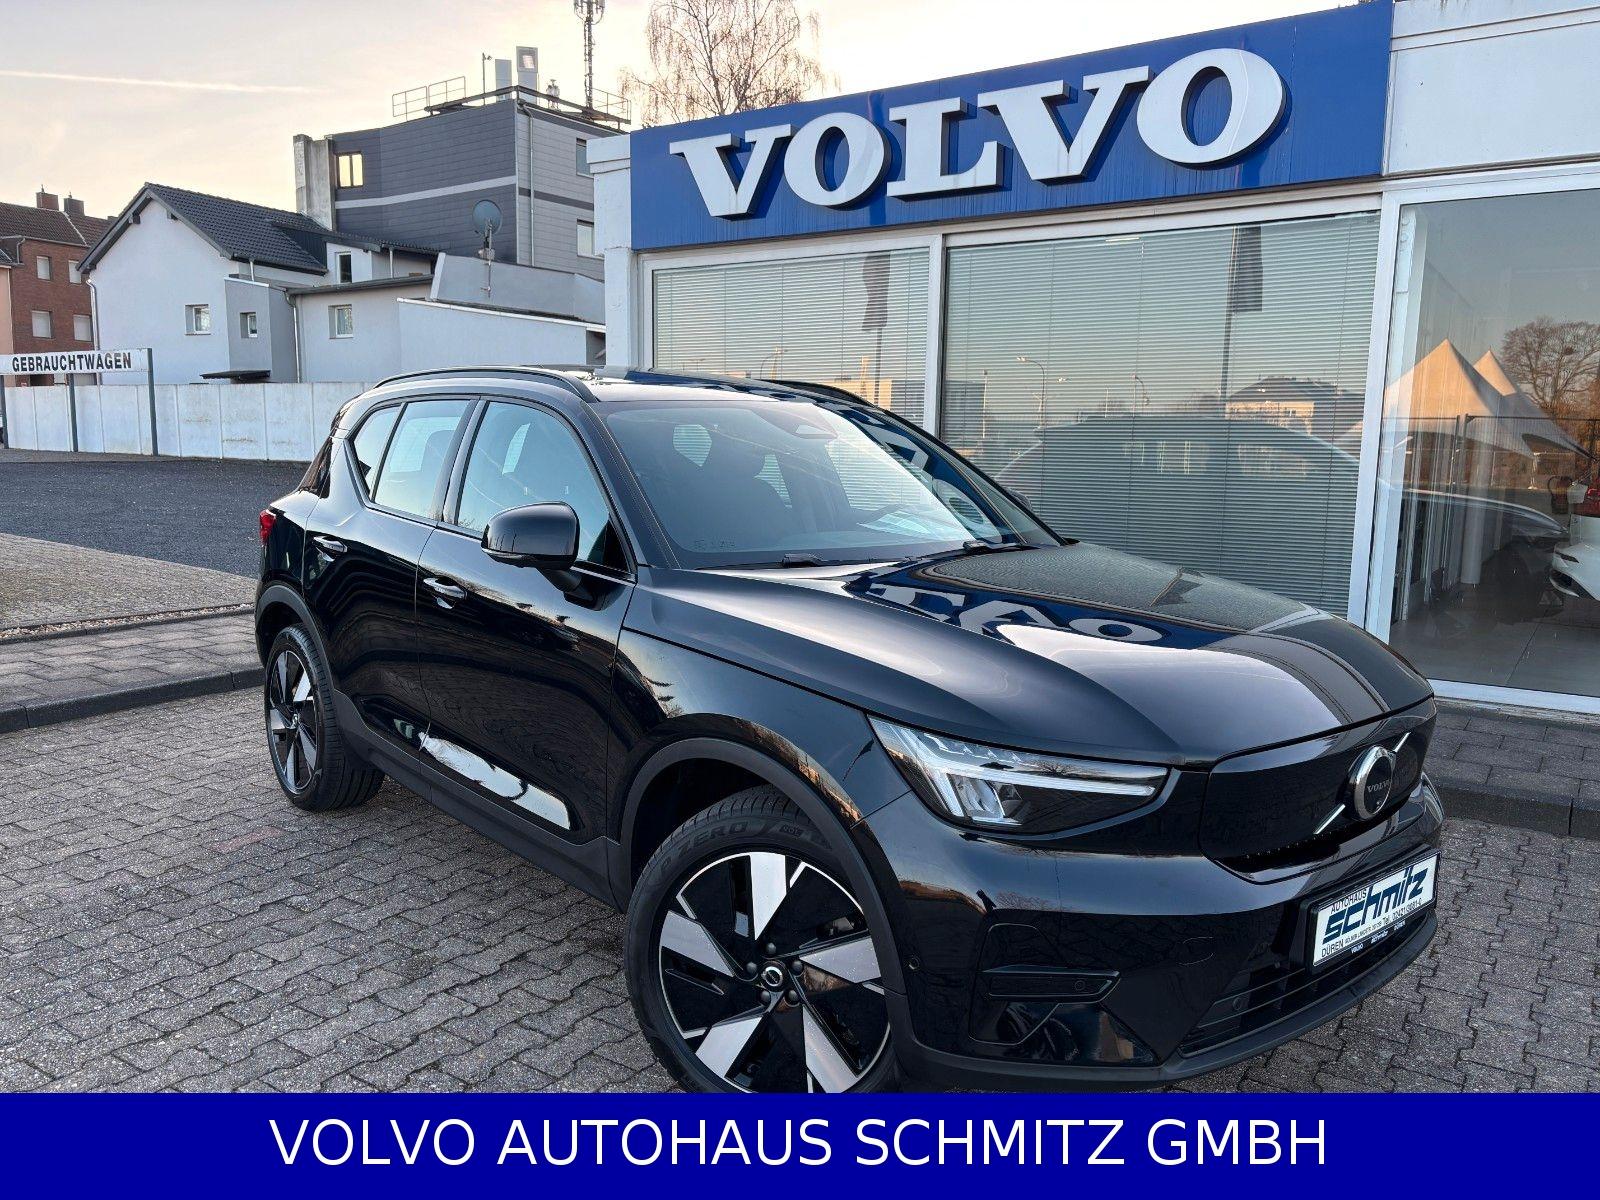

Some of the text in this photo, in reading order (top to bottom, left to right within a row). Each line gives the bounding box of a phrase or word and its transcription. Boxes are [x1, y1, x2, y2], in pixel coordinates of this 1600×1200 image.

[669, 48, 1287, 218] VOLVO
[12, 352, 132, 372] GEBRAUCHTWAGEN
[1330, 888, 1367, 914] AUTOHAUS
[1321, 938, 1344, 958] DÜREN
